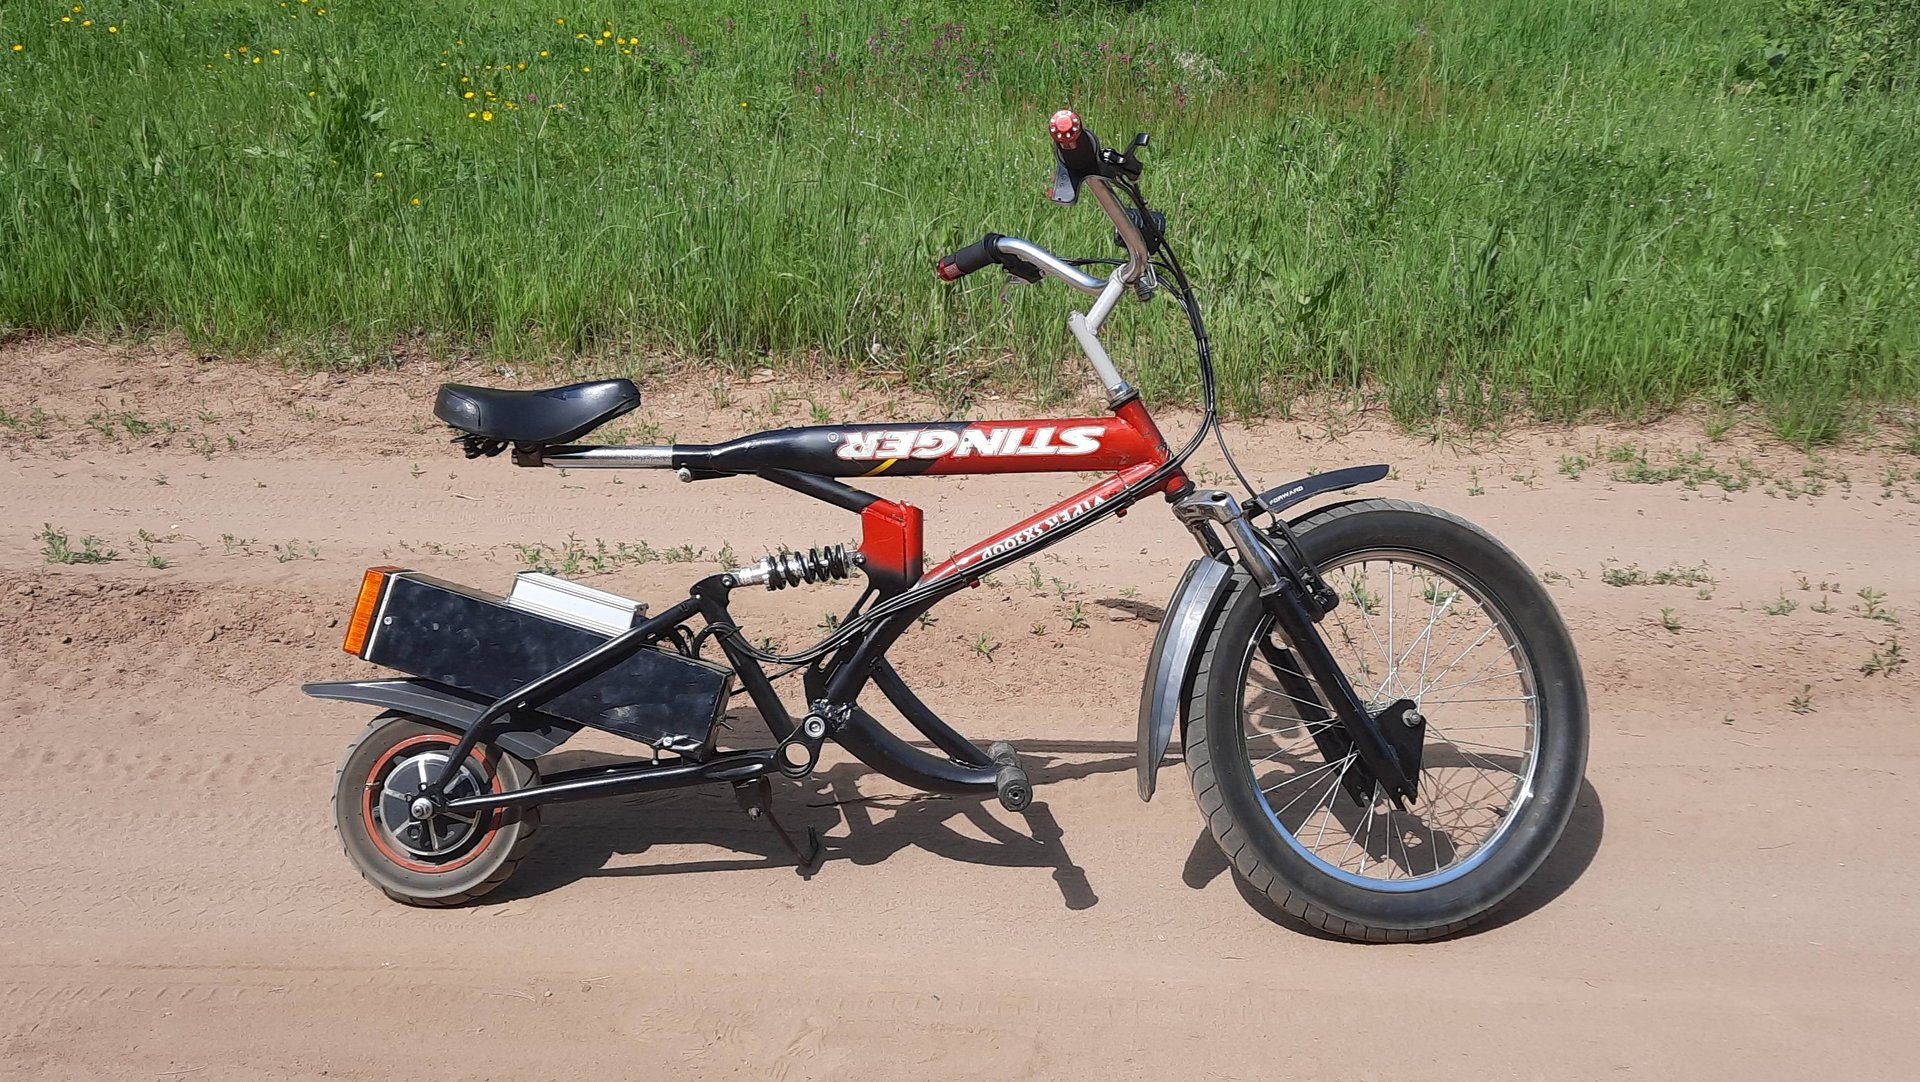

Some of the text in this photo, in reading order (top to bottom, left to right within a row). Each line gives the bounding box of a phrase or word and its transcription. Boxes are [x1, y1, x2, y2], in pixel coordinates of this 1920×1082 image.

[836, 426, 1105, 460] STINGER
[1046, 495, 1105, 528] VIPER
[1269, 485, 1304, 505] FORWARD
